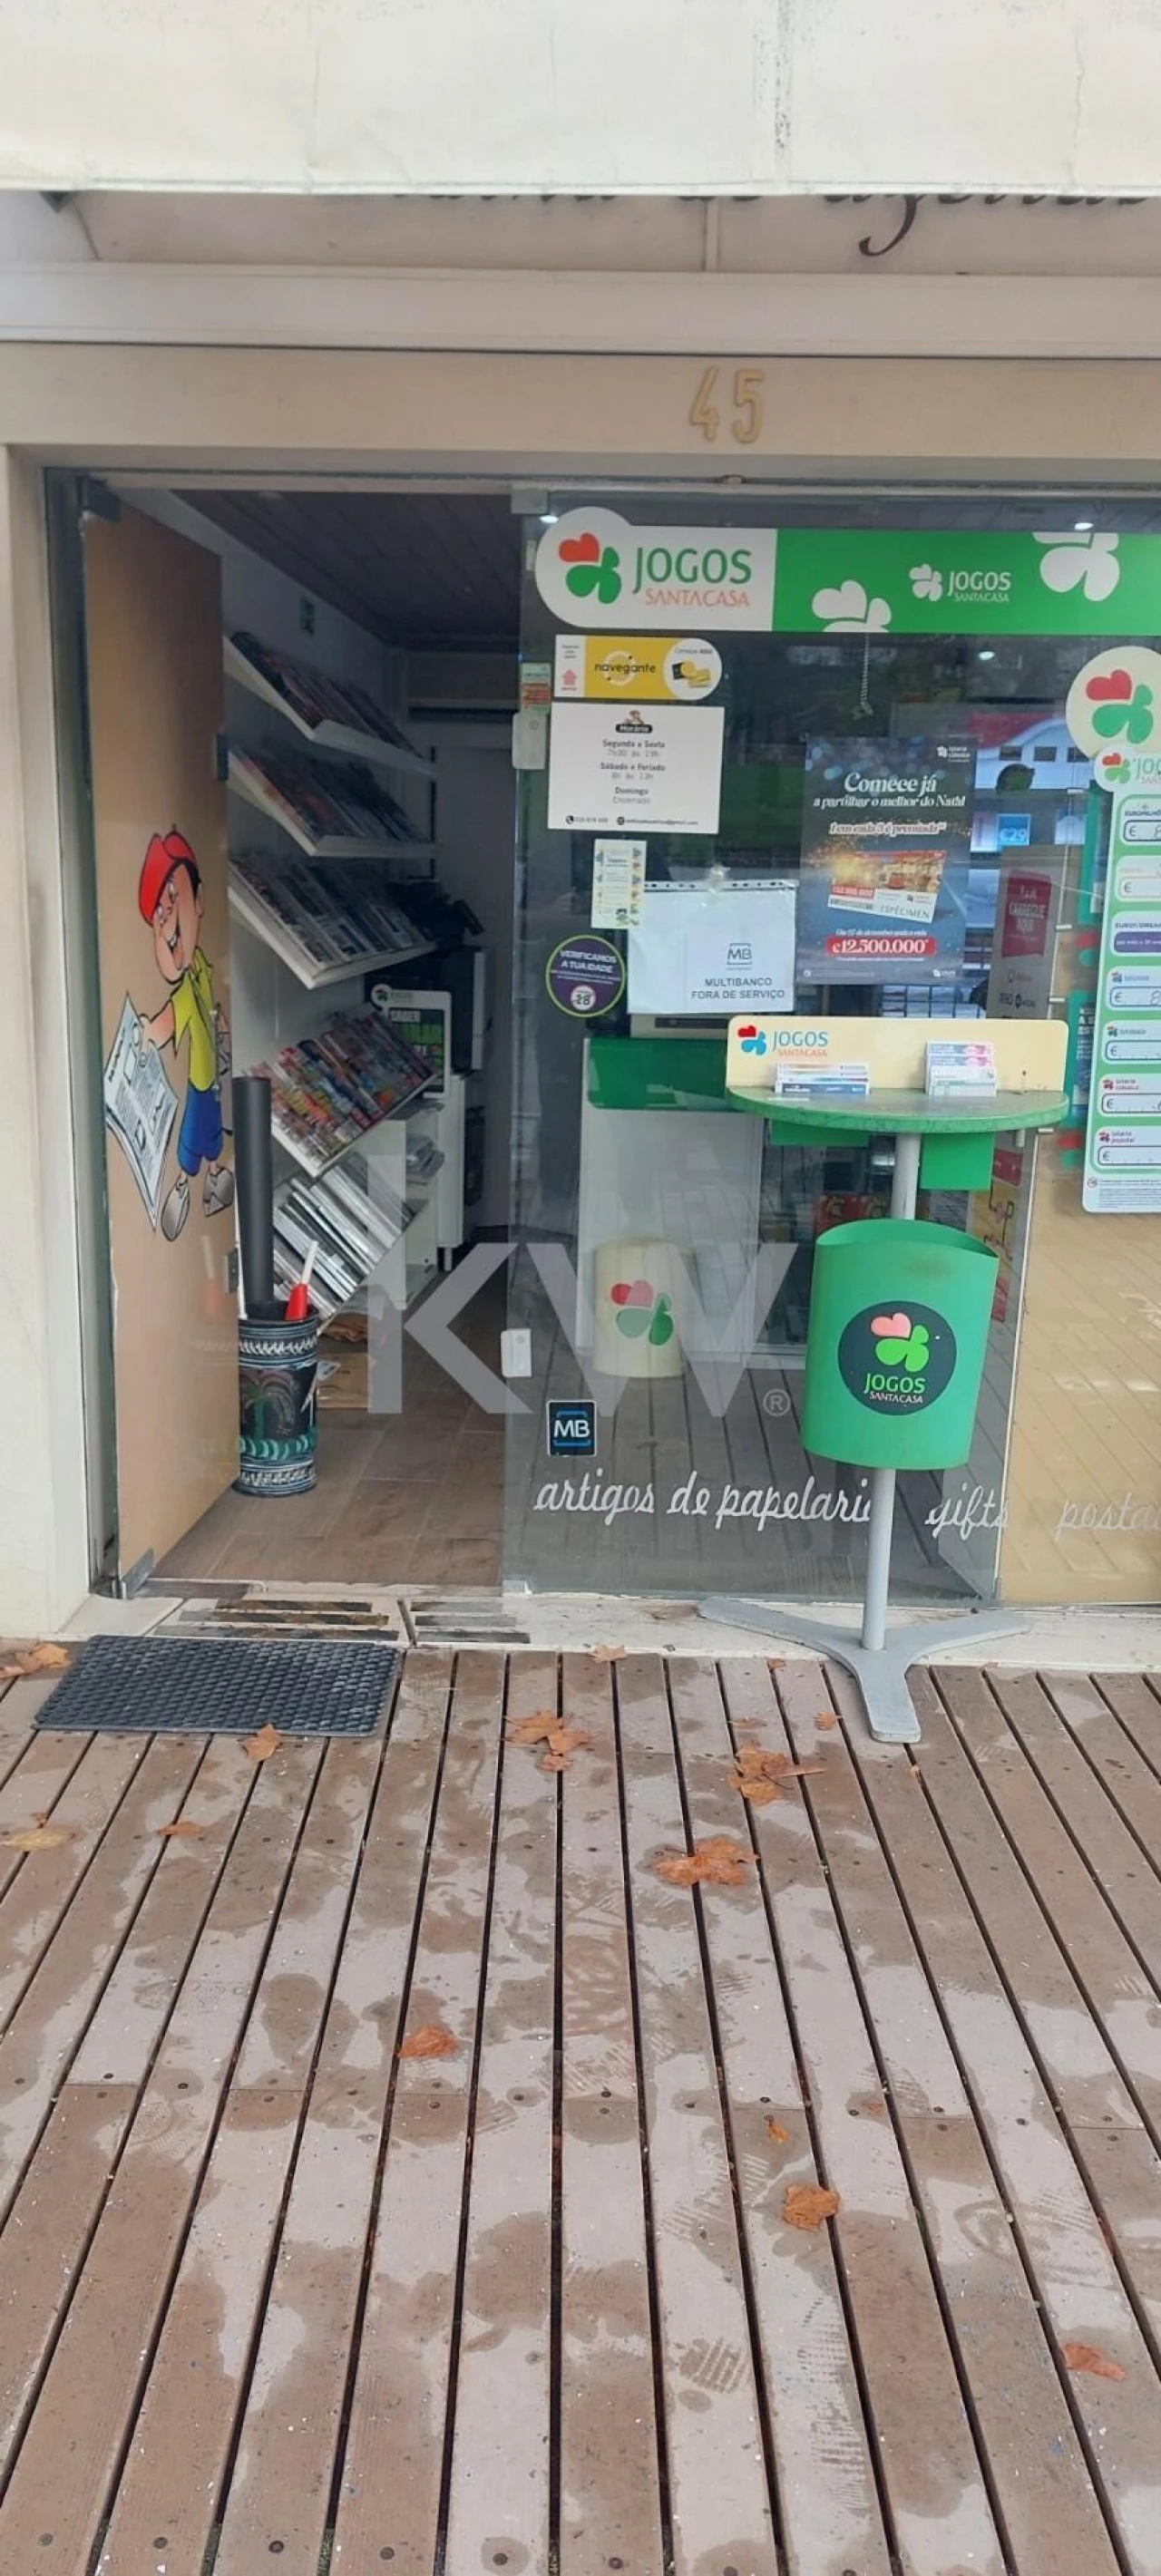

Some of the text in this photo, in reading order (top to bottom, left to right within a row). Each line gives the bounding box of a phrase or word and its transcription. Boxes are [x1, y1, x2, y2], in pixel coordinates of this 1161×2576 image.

[690, 368, 766, 442] 45
[632, 547, 752, 594] JOGOS
[948, 570, 1011, 596] JOGOS
[594, 662, 656, 675] navegante
[844, 772, 938, 797] Comece já
[814, 798, 821, 806] a
[821, 794, 871, 809] partilhar
[880, 795, 919, 806] melhor
[920, 795, 934, 806] do
[936, 794, 966, 807] Natal
[727, 948, 752, 959] MB
[705, 977, 772, 987] MULTIBANCO
[691, 989, 785, 999] FORA DE SERVIÇO
[773, 1031, 828, 1051] JOGOS
[864, 1373, 925, 1394] JOGOS
[553, 1420, 590, 1437] MB
[533, 1468, 655, 1526] artigos
[667, 1471, 707, 1515] de
[715, 1475, 871, 1531] papelari
[924, 1482, 1009, 1541] gifts
